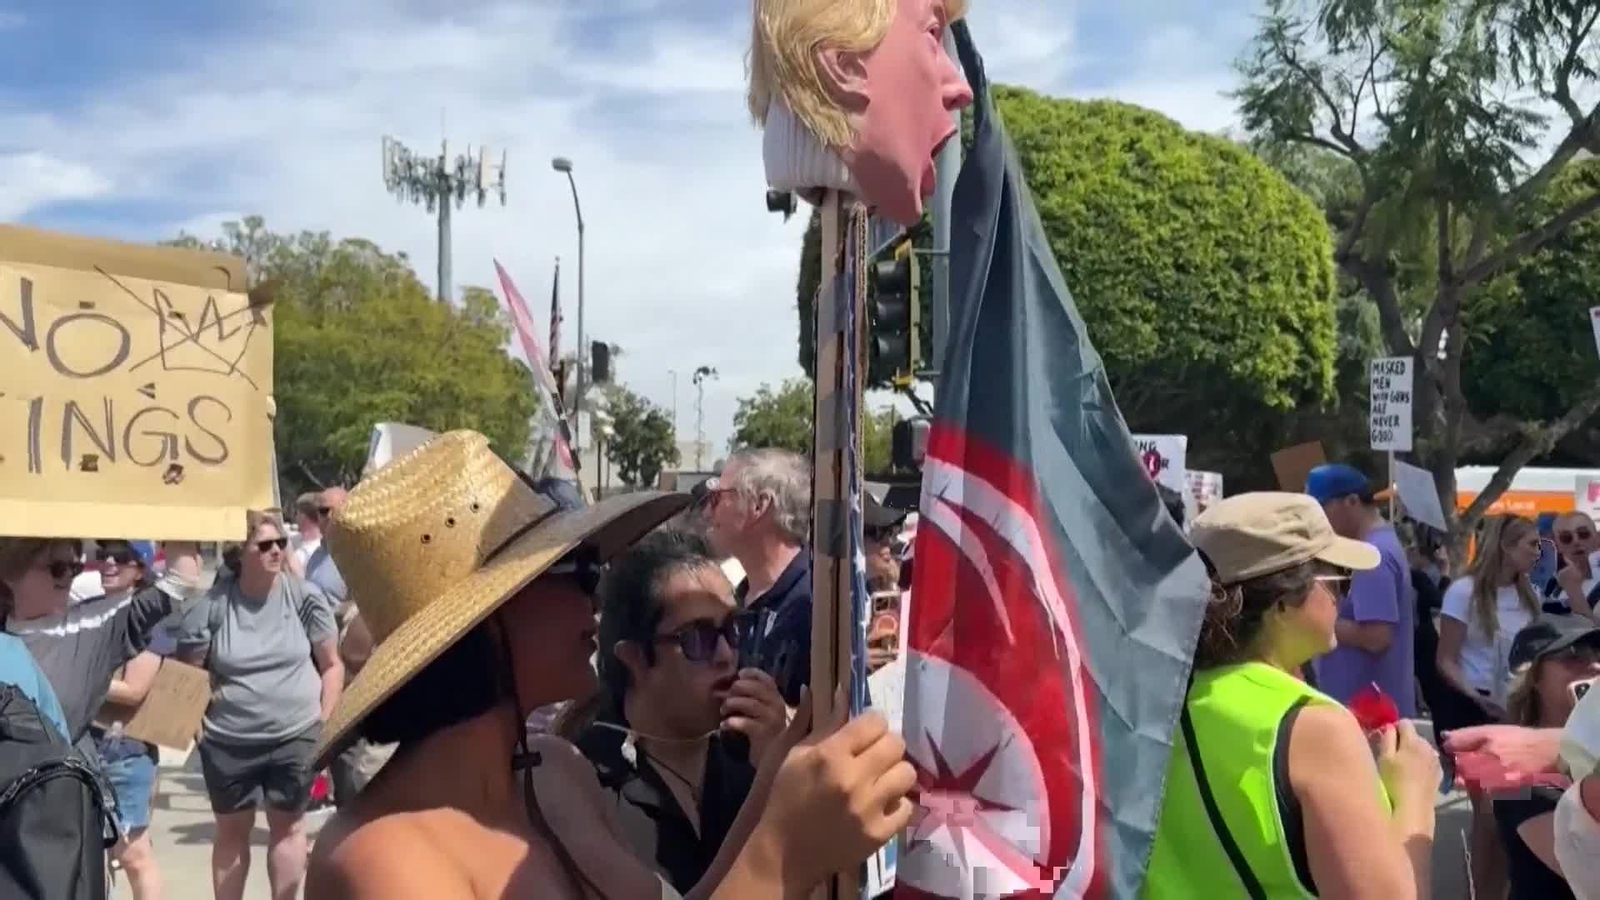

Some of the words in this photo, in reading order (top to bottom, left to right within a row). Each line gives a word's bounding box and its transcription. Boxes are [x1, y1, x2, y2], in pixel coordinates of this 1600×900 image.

[1373, 360, 1405, 375] MASKED
[1373, 376, 1390, 389] MEN
[1373, 392, 1388, 402] WITH
[1390, 391, 1410, 404] GUNS
[1373, 403, 1386, 414] ARE
[1373, 415, 1400, 427] NEVER
[0, 393, 232, 474] INGS
